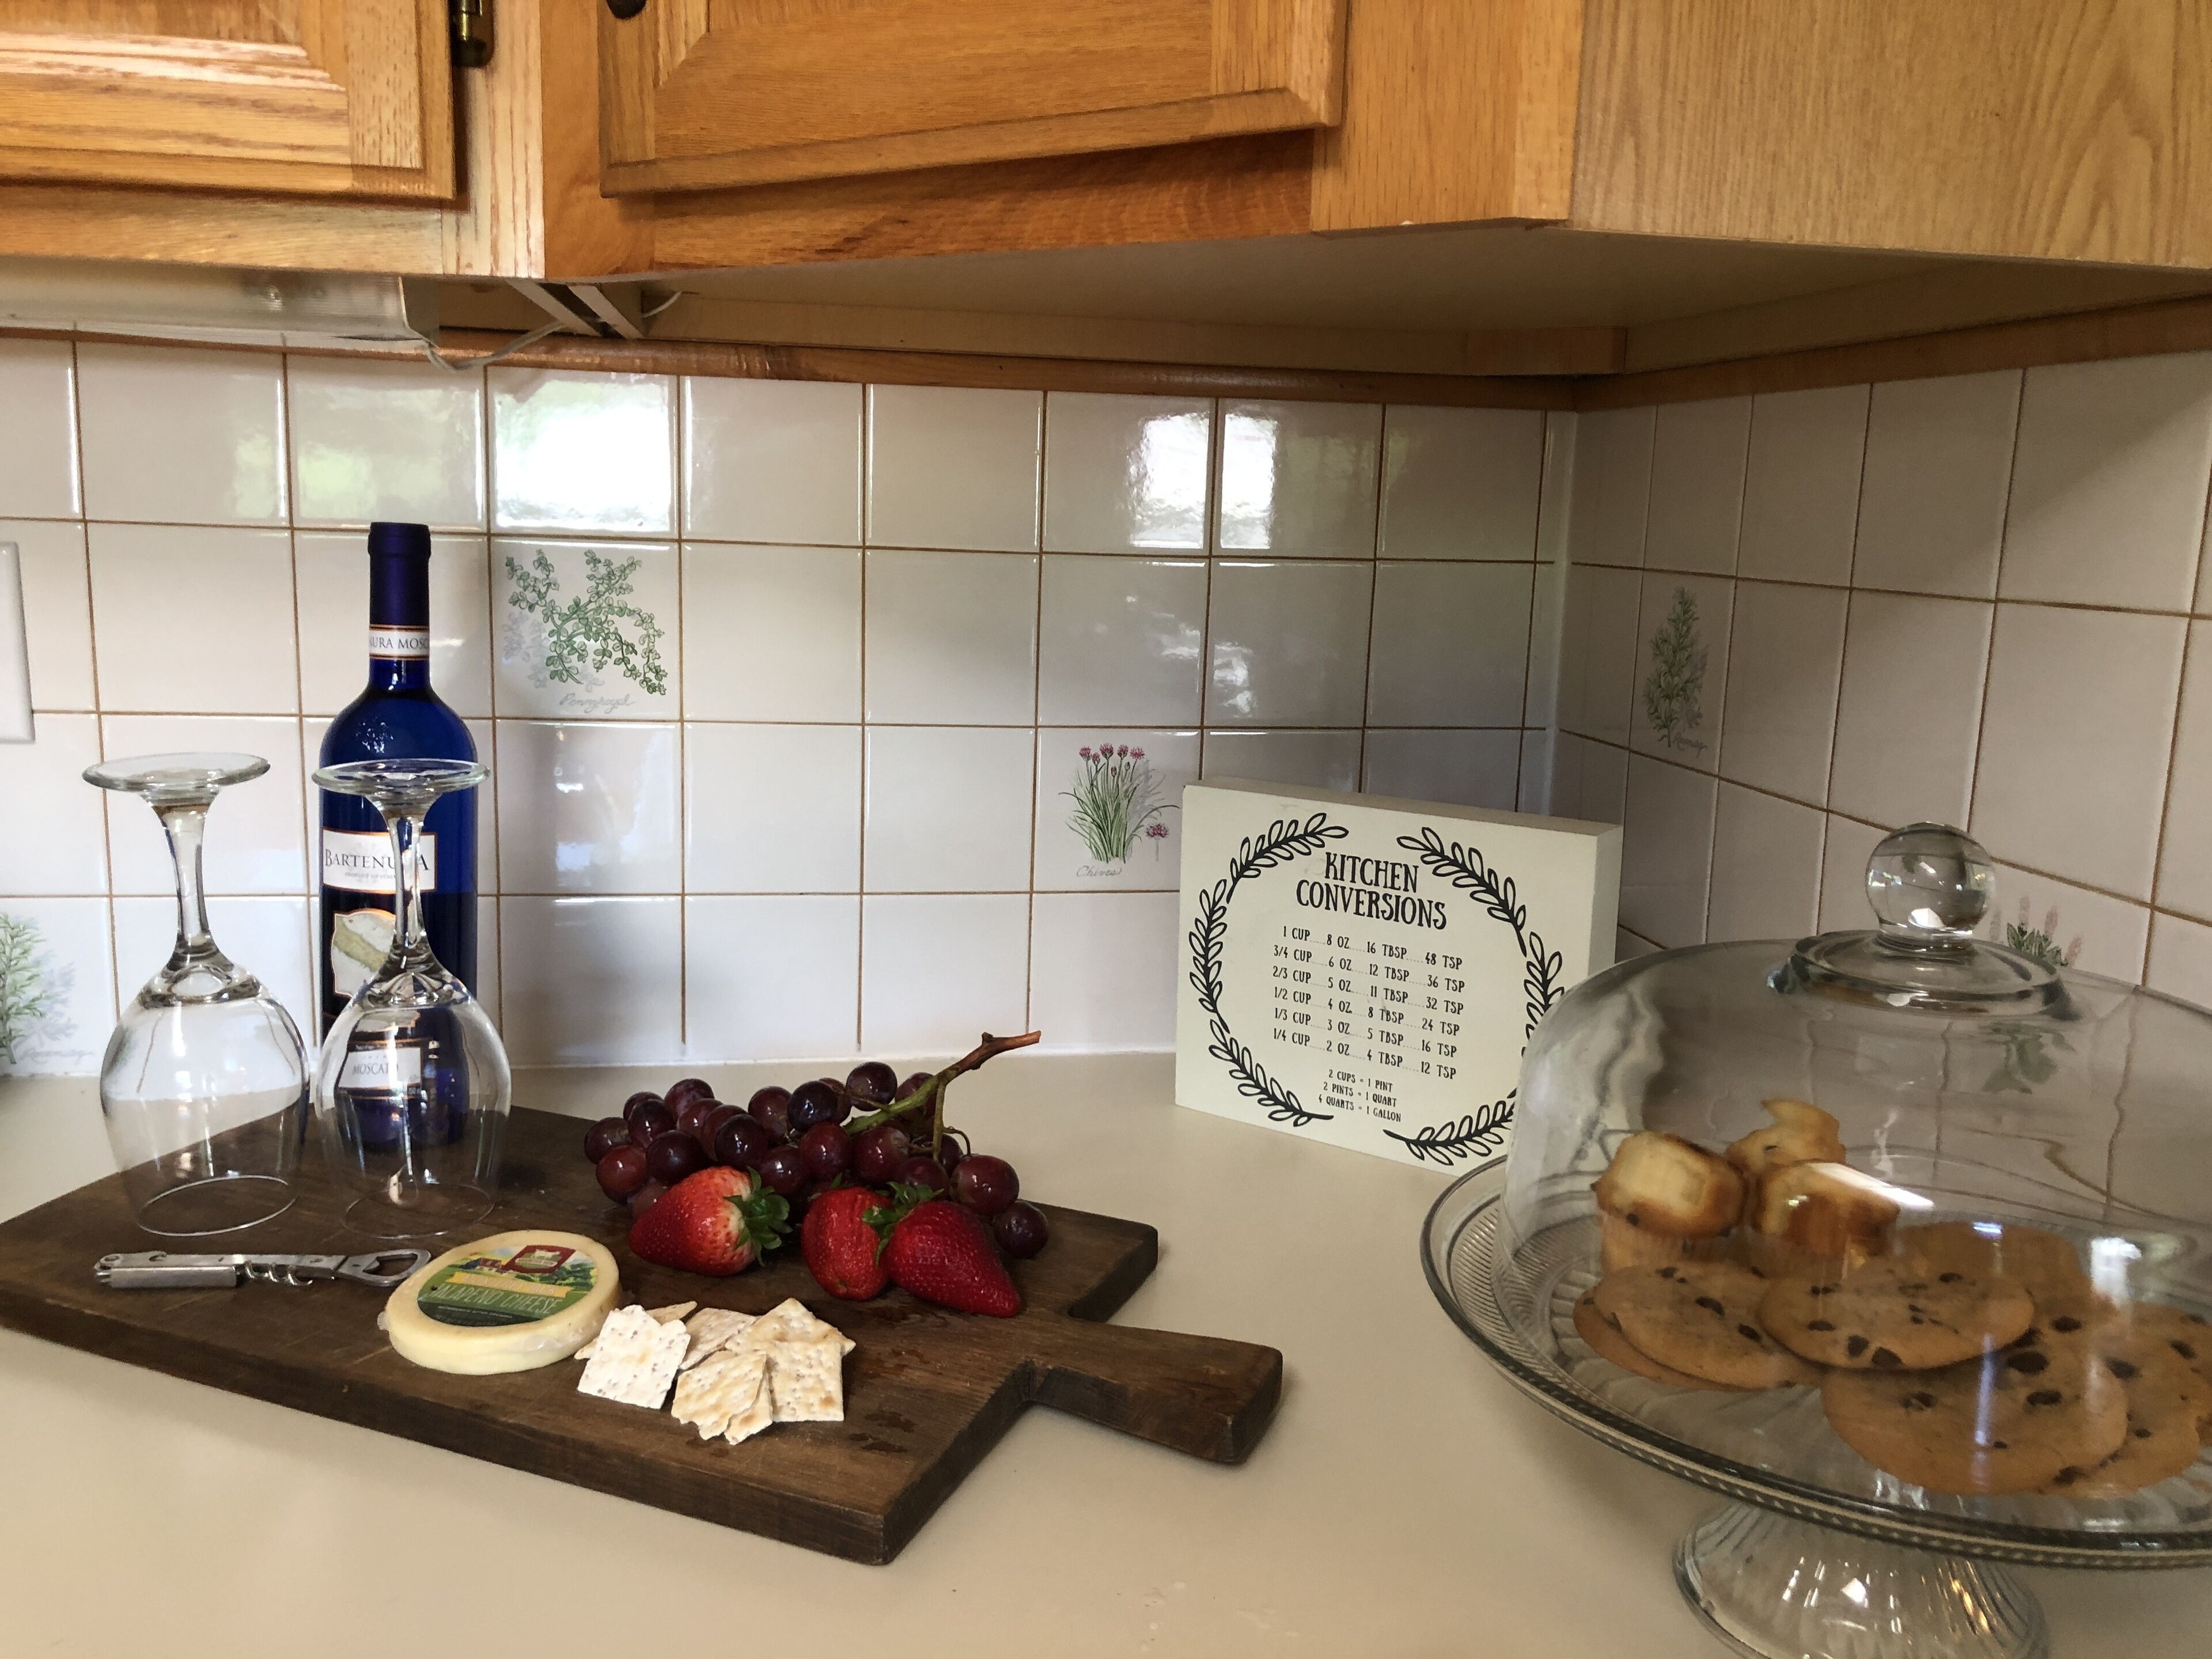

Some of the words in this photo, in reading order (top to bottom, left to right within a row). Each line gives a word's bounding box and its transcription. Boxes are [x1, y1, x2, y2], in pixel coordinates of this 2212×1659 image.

[559, 692, 636, 714] Pennyroyal
[325, 849, 430, 870] BARTENUA
[1077, 865, 1122, 878] Chives
[1324, 851, 1419, 893] KITCHEN
[1296, 879, 1447, 930] CONVERSIONS
[1274, 944, 1289, 959] 3/4
[1293, 949, 1312, 963] CUP
[1328, 956, 1335, 968] 6
[1339, 957, 1352, 971] OZ
[1369, 963, 1378, 977] 12
[1384, 966, 1410, 982] TBSP
[1427, 974, 1439, 988] 36
[1444, 978, 1465, 993] TSP
[1283, 925, 1287, 937] 1
[1291, 927, 1310, 941] CUP
[1327, 934, 1332, 946] 8
[1337, 935, 1350, 949] OZ
[1366, 941, 1376, 954] 16
[1381, 944, 1407, 960] TBSP
[1425, 952, 1437, 966] 48
[1442, 955, 1463, 970] TSP
[1272, 965, 1288, 979] 2/3
[1292, 969, 1312, 984] CUP
[1327, 976, 1334, 989] 5
[1338, 979, 1351, 993] OZ
[1370, 984, 1377, 998] 11
[1382, 987, 1408, 1004] TBSP
[1426, 996, 1438, 1010] 32
[1443, 999, 1464, 1015] TSP
[1274, 986, 1288, 1001] 1/2
[1293, 990, 1312, 1005] CUP
[1328, 998, 1333, 1010] 4
[1368, 1006, 1374, 1018] 8
[1379, 1008, 1404, 1025] TBSP
[1421, 1017, 1434, 1032] 24
[1440, 1021, 1460, 1036] TSP
[1274, 1027, 1287, 1042] 1/4
[1291, 1032, 1310, 1047] CUP
[1326, 1040, 1332, 1052] 2
[1337, 1042, 1350, 1056] OZ
[1366, 1049, 1373, 1062] 4
[1378, 1051, 1403, 1068] TBSP
[1421, 1060, 1430, 1075] 12
[1436, 1064, 1457, 1080] TSP
[1275, 1007, 1288, 1021] 1/3
[1292, 1012, 1311, 1026] CUP
[1327, 1018, 1333, 1031] 3
[1338, 1021, 1350, 1035] OZ
[1367, 1027, 1373, 1040] 5
[1378, 1030, 1404, 1046] TBSP
[1421, 1039, 1431, 1052] 16
[1437, 1042, 1457, 1058] TSP
[1323, 1081, 1328, 1091] 2
[1332, 1083, 1354, 1097] PINTS
[1366, 1091, 1369, 1101] 1
[1372, 1093, 1397, 1108] QUART
[1328, 1069, 1334, 1078] 2
[1336, 1071, 1356, 1084] CUPS
[1368, 1078, 1371, 1088] 1
[1375, 1080, 1393, 1093] PINT
[1318, 1093, 1323, 1104] 4
[1325, 1096, 1354, 1111] QUARTS
[1366, 1105, 1369, 1115] 1
[1373, 1107, 1402, 1123] GALLON
[499, 1293, 563, 1313] CHEESE
